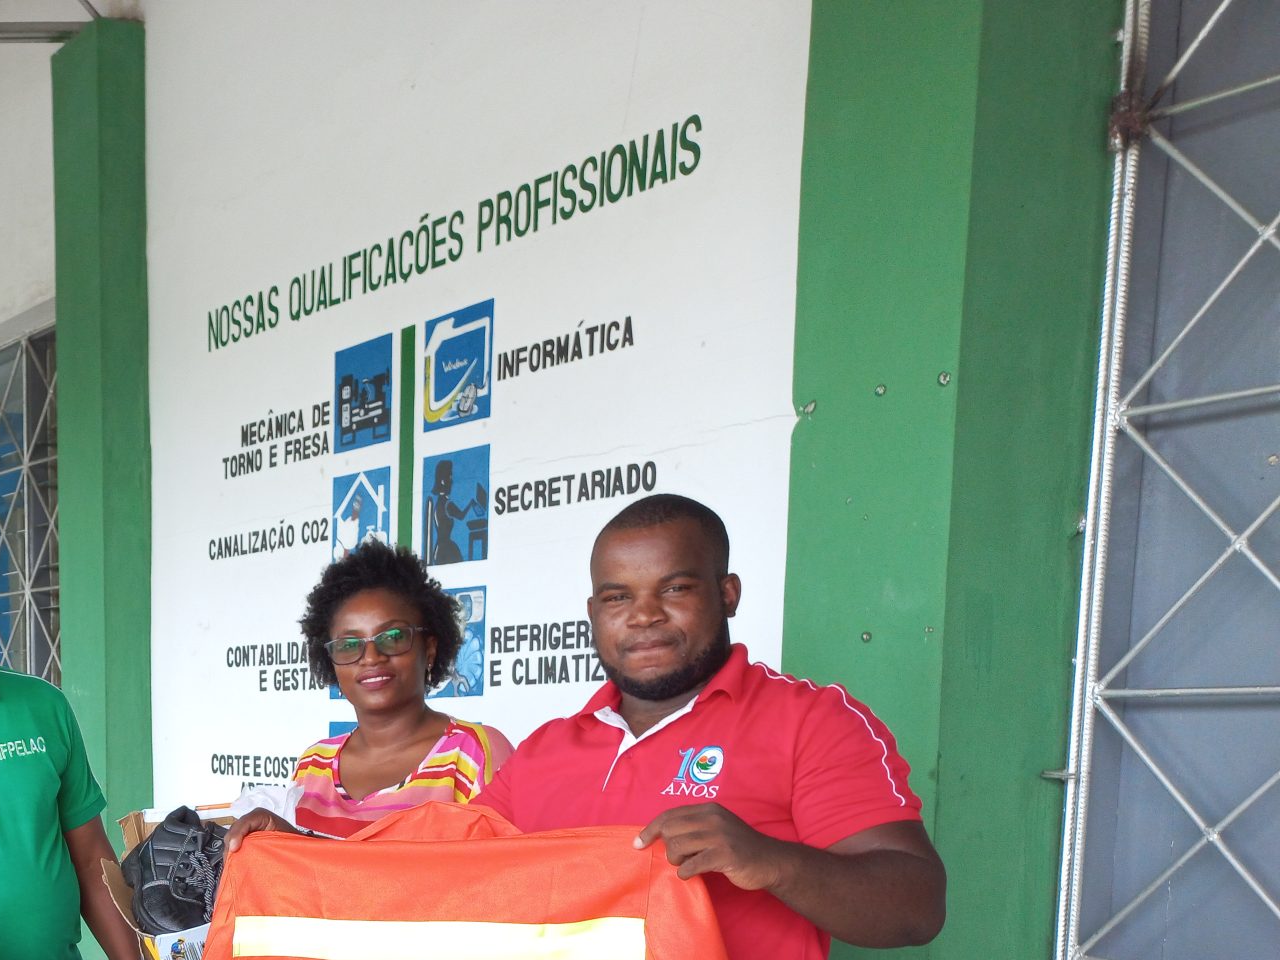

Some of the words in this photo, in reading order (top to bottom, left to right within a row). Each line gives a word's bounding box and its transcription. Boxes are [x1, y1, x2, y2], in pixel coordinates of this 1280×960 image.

[207, 286, 279, 352] NOSSAS
[476, 113, 703, 253] PROFISSIONAIS
[496, 315, 635, 382] INFORMÁTICA
[240, 409, 304, 448] MECÂNICA
[312, 400, 330, 429] DE
[222, 448, 263, 480] TORNO
[269, 444, 277, 468] E
[284, 430, 330, 465] FRESA
[494, 460, 658, 516] SECRETARIADO
[259, 669, 268, 692] E
[489, 660, 502, 687] E
[211, 753, 250, 776] CORTE
[253, 756, 262, 778] E
[661, 782, 720, 799] ANOS
